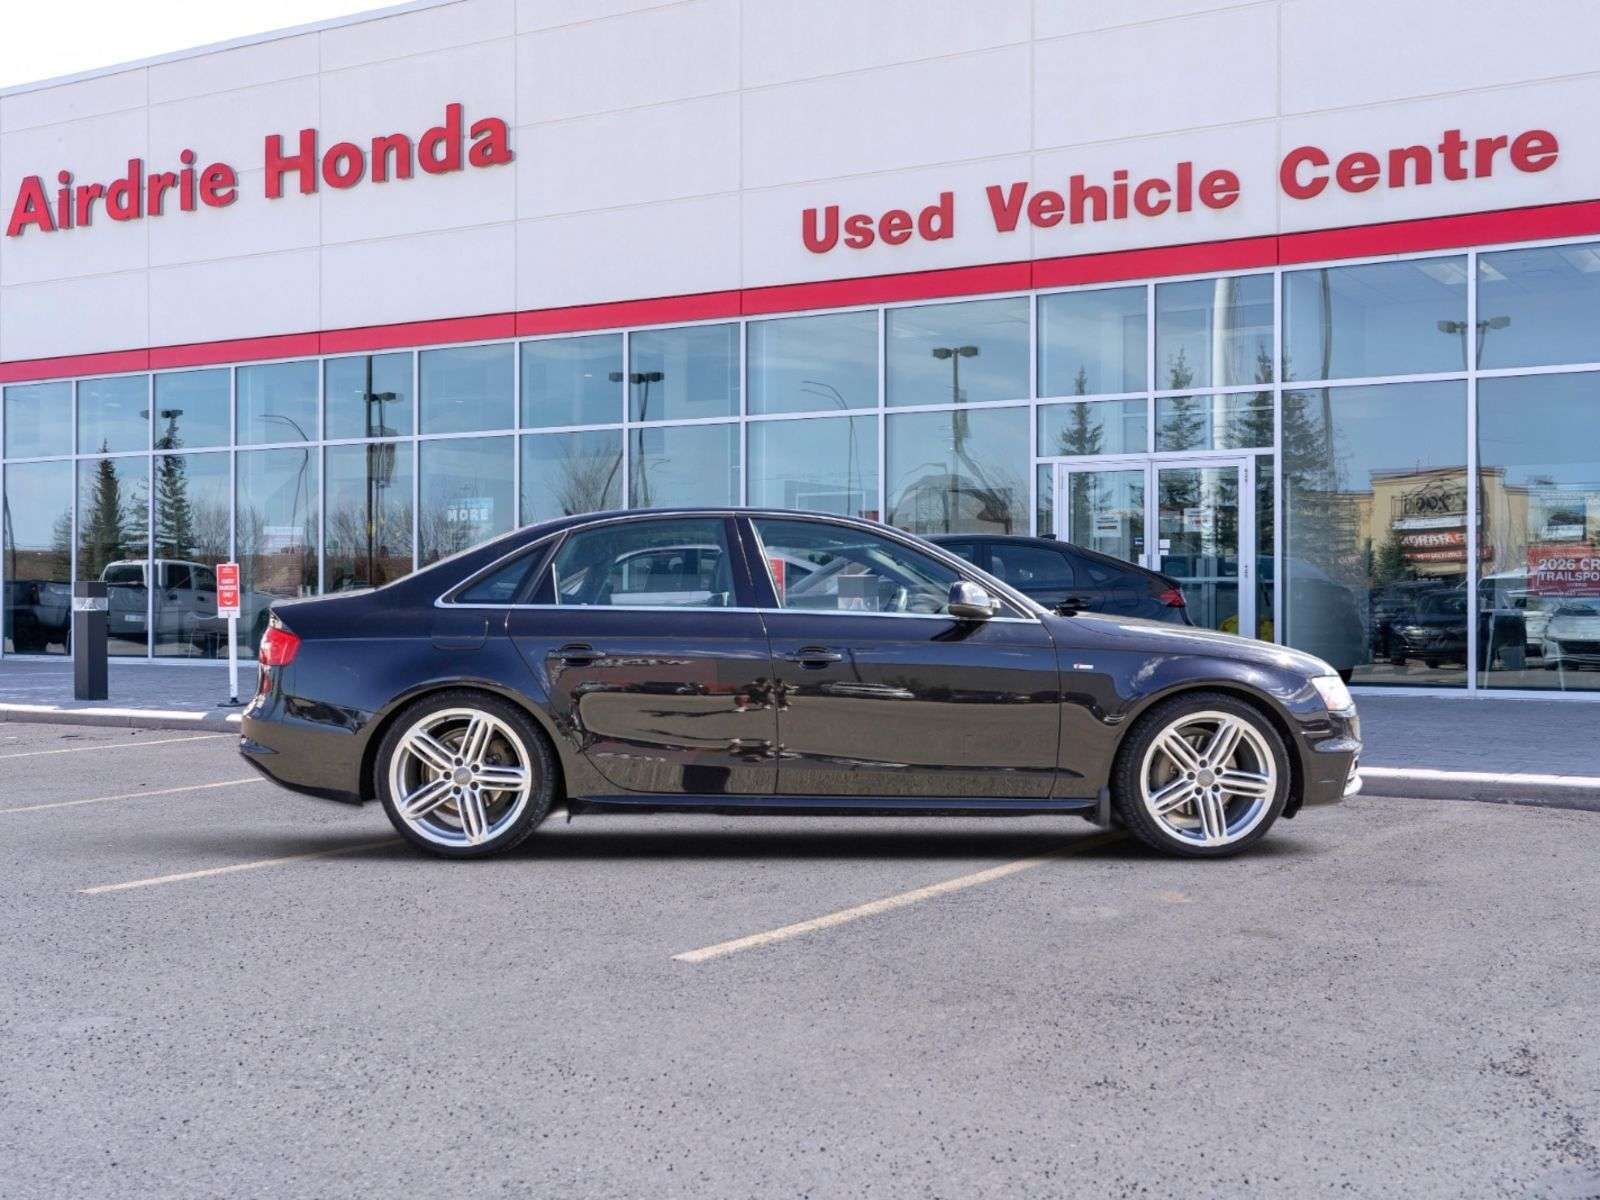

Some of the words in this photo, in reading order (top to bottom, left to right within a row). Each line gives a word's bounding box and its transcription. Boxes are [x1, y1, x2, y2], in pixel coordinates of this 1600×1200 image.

[7, 149, 237, 236] Airdrie
[264, 103, 513, 199] Honda
[803, 192, 954, 253] Used
[986, 162, 1239, 232] Vehicle
[1279, 130, 1558, 199] Centre
[1539, 558, 1576, 570] 2026
